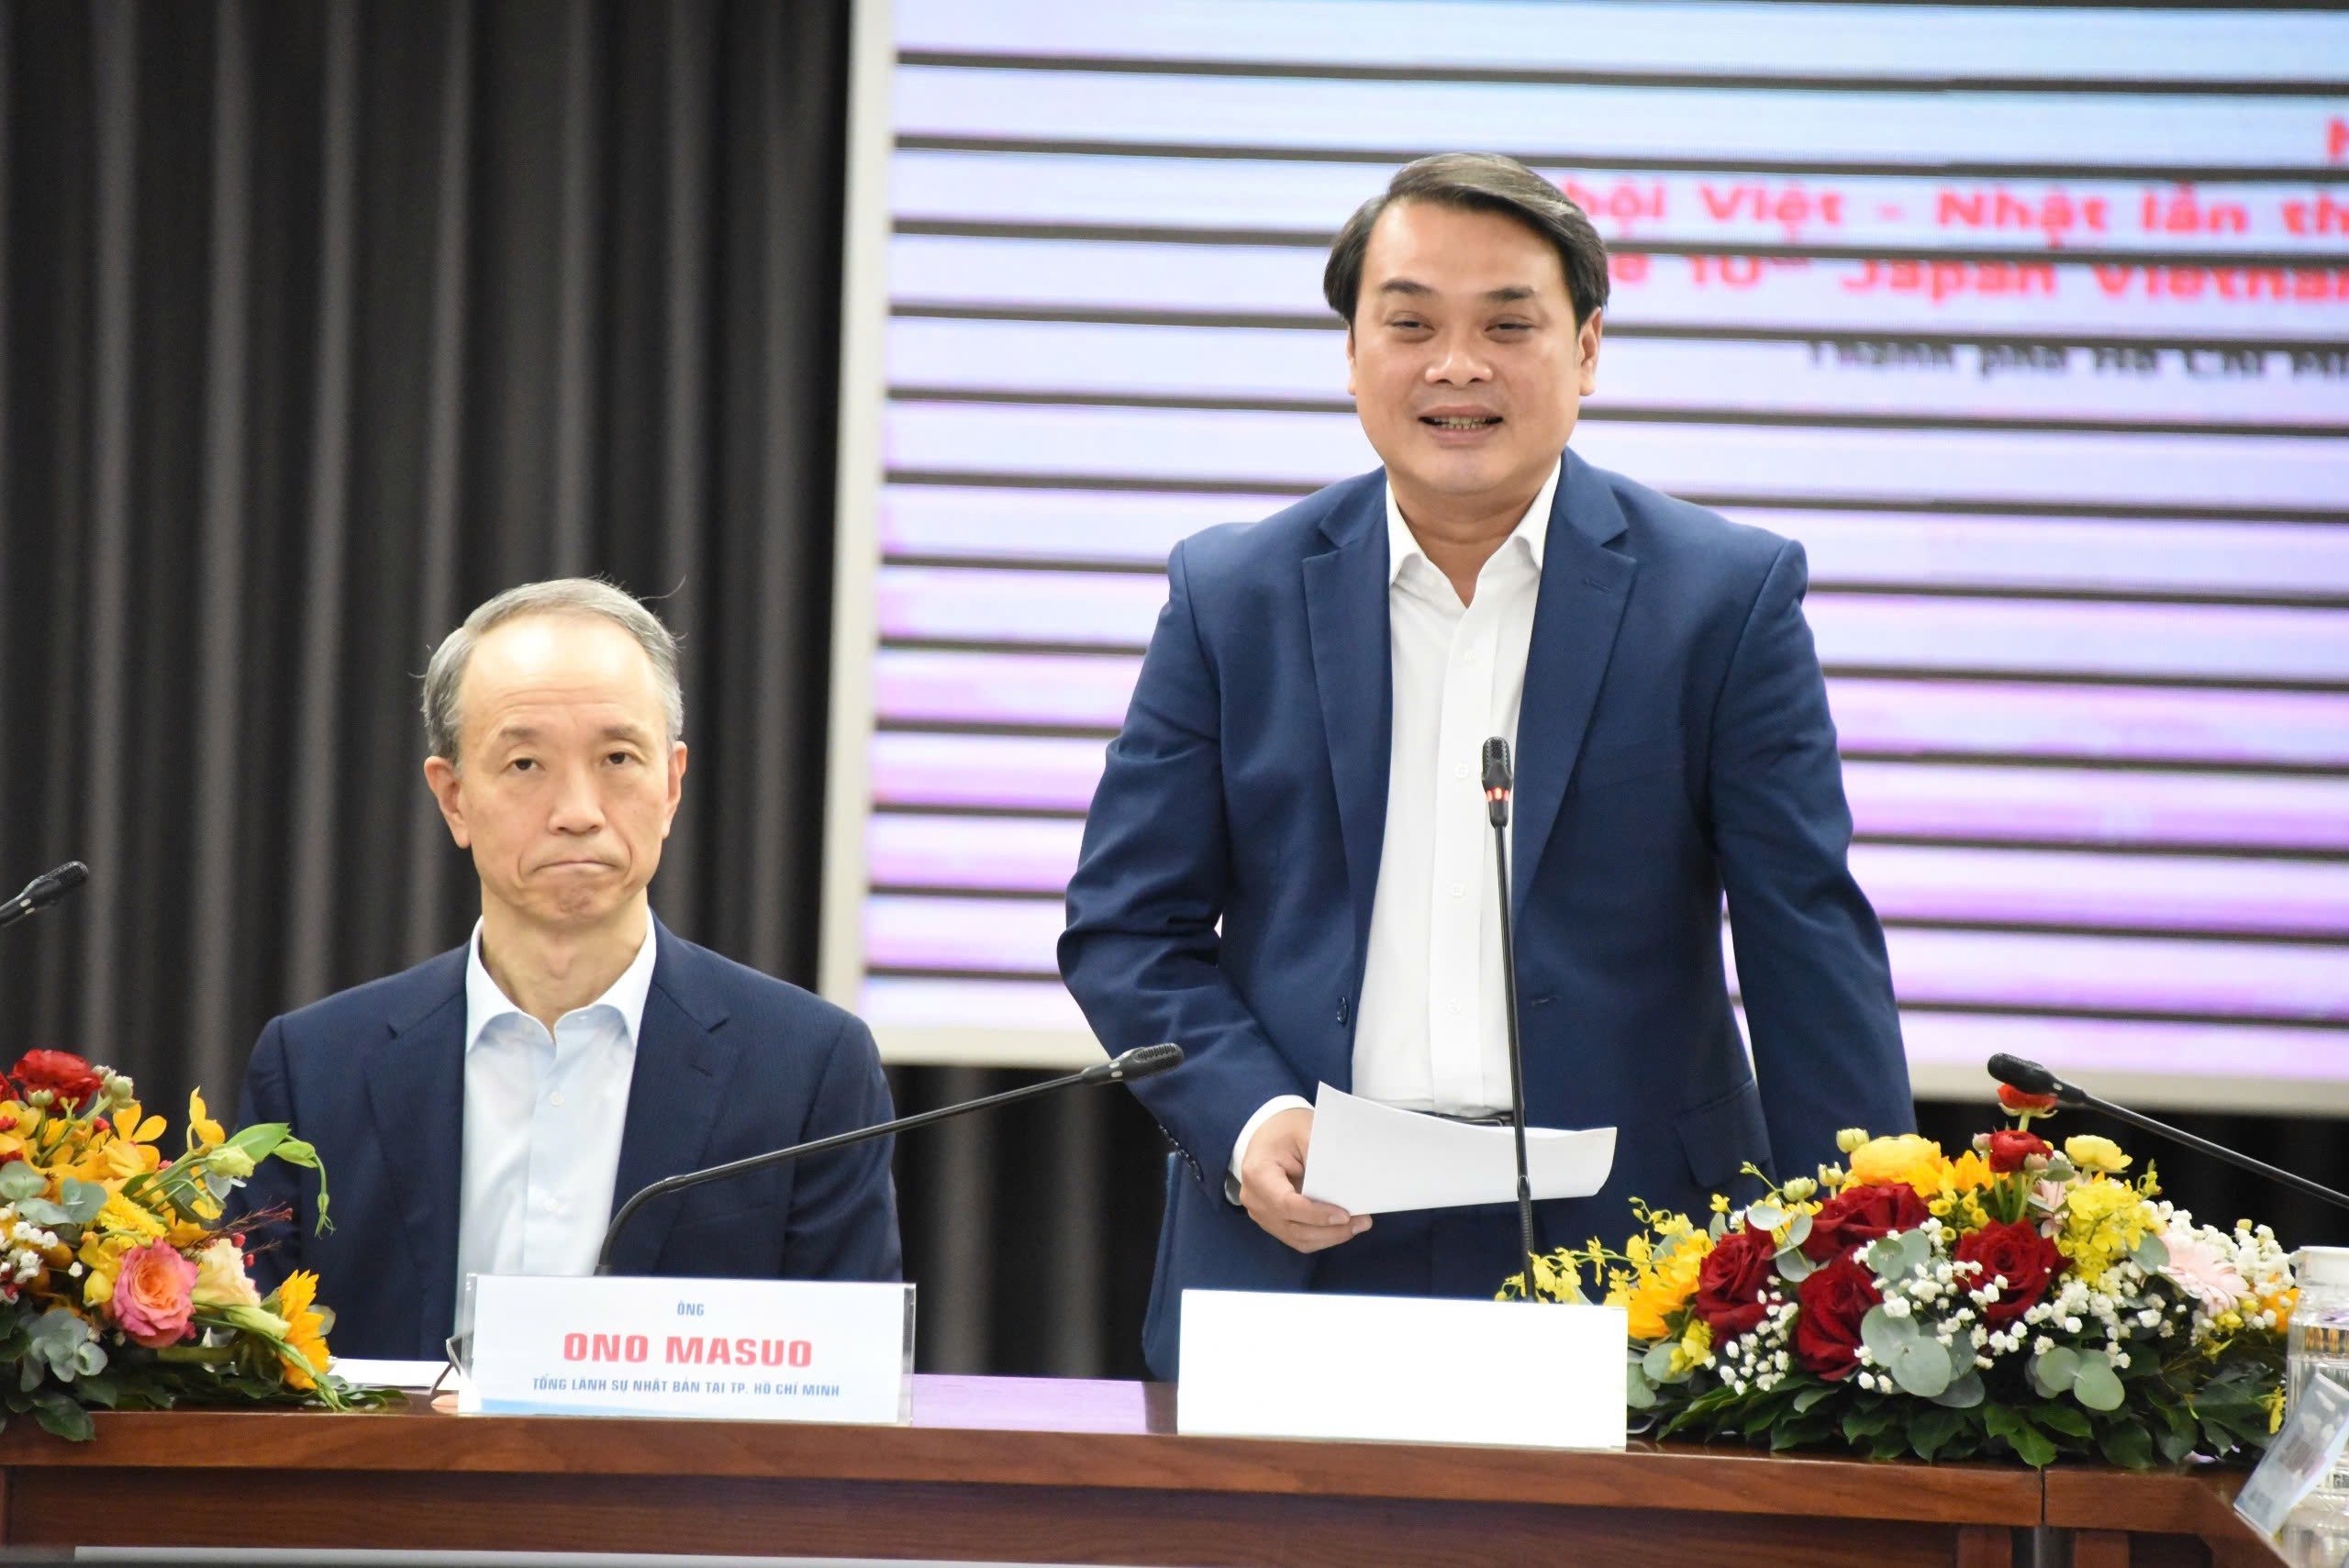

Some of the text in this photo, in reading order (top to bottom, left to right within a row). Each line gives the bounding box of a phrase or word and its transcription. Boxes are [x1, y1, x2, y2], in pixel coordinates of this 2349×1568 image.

[1699, 182, 1842, 243] Việt
[1937, 187, 2107, 249] Nhật
[563, 1332, 812, 1368] ONO MASUO
[730, 1382, 749, 1395] TP.
[775, 1381, 798, 1396] CHÍ
[802, 1384, 841, 1397] MINH
